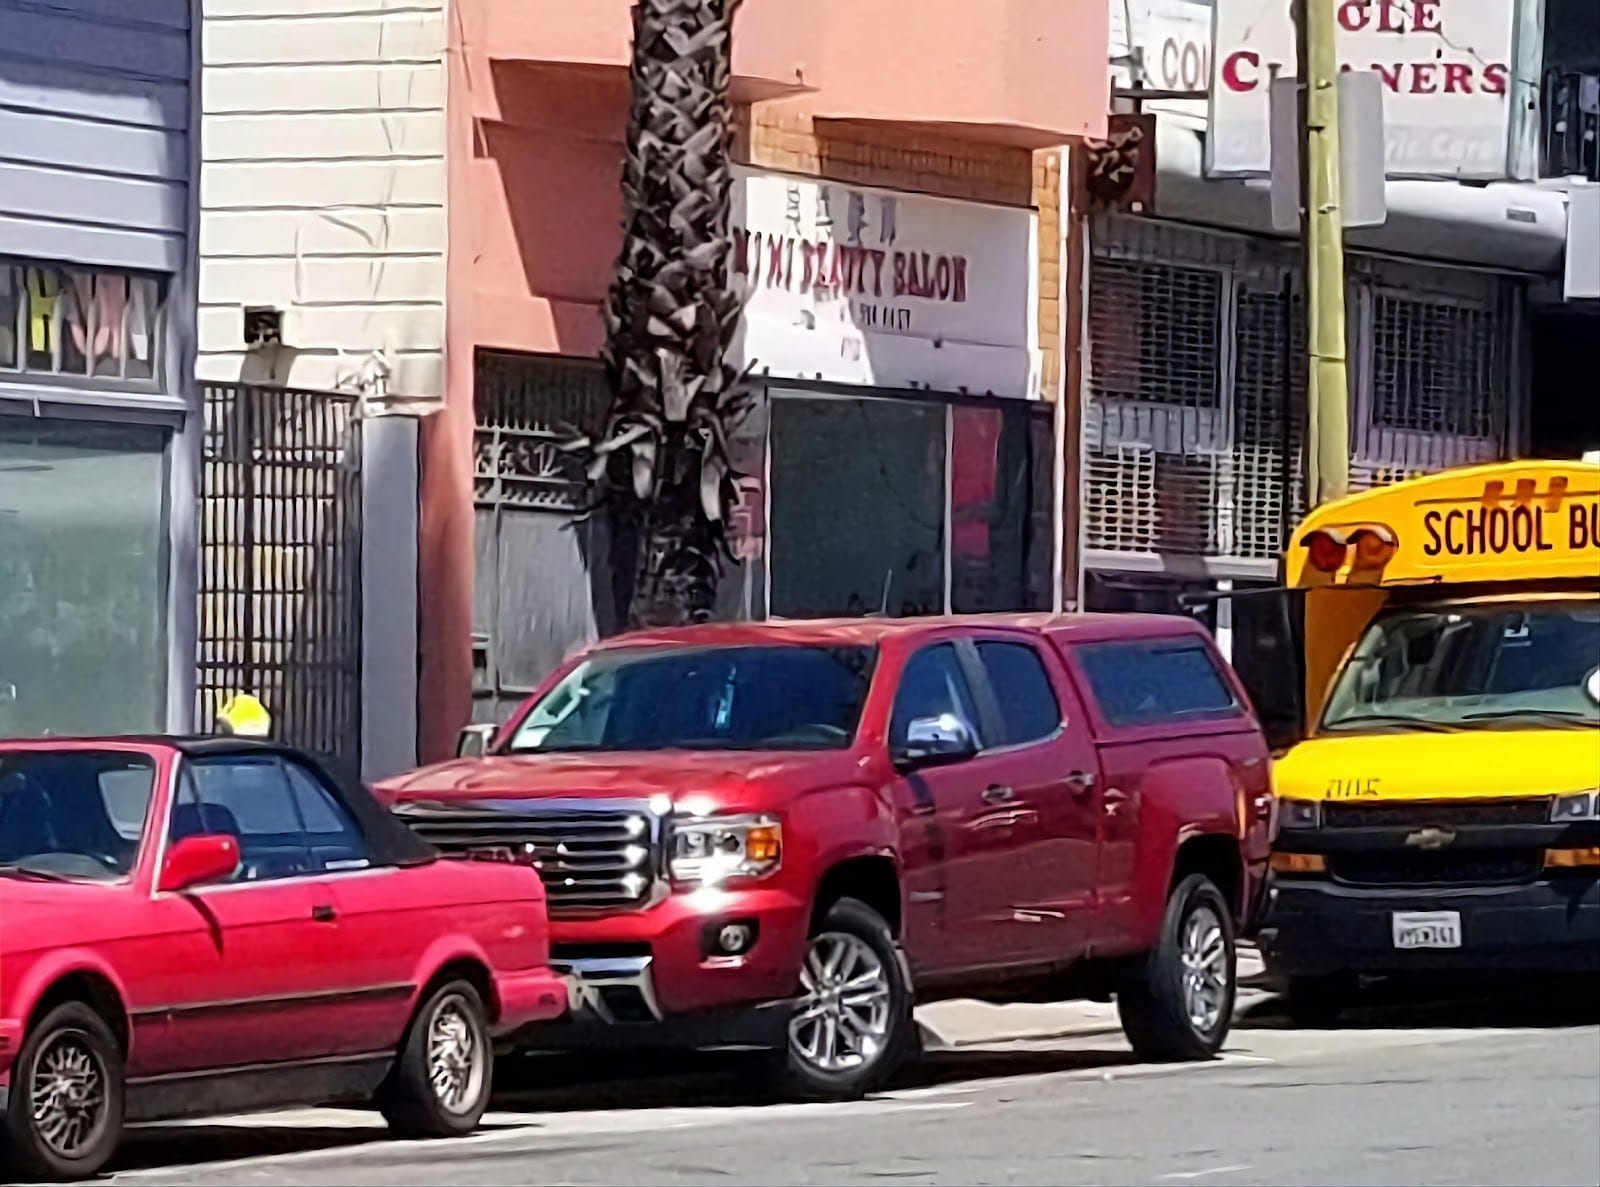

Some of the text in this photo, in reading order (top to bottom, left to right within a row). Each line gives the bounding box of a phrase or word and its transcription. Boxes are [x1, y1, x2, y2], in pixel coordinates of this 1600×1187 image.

[1222, 51, 1509, 94] CNERS
[893, 250, 967, 302] SALON
[1423, 504, 1553, 556] SCHOOL
